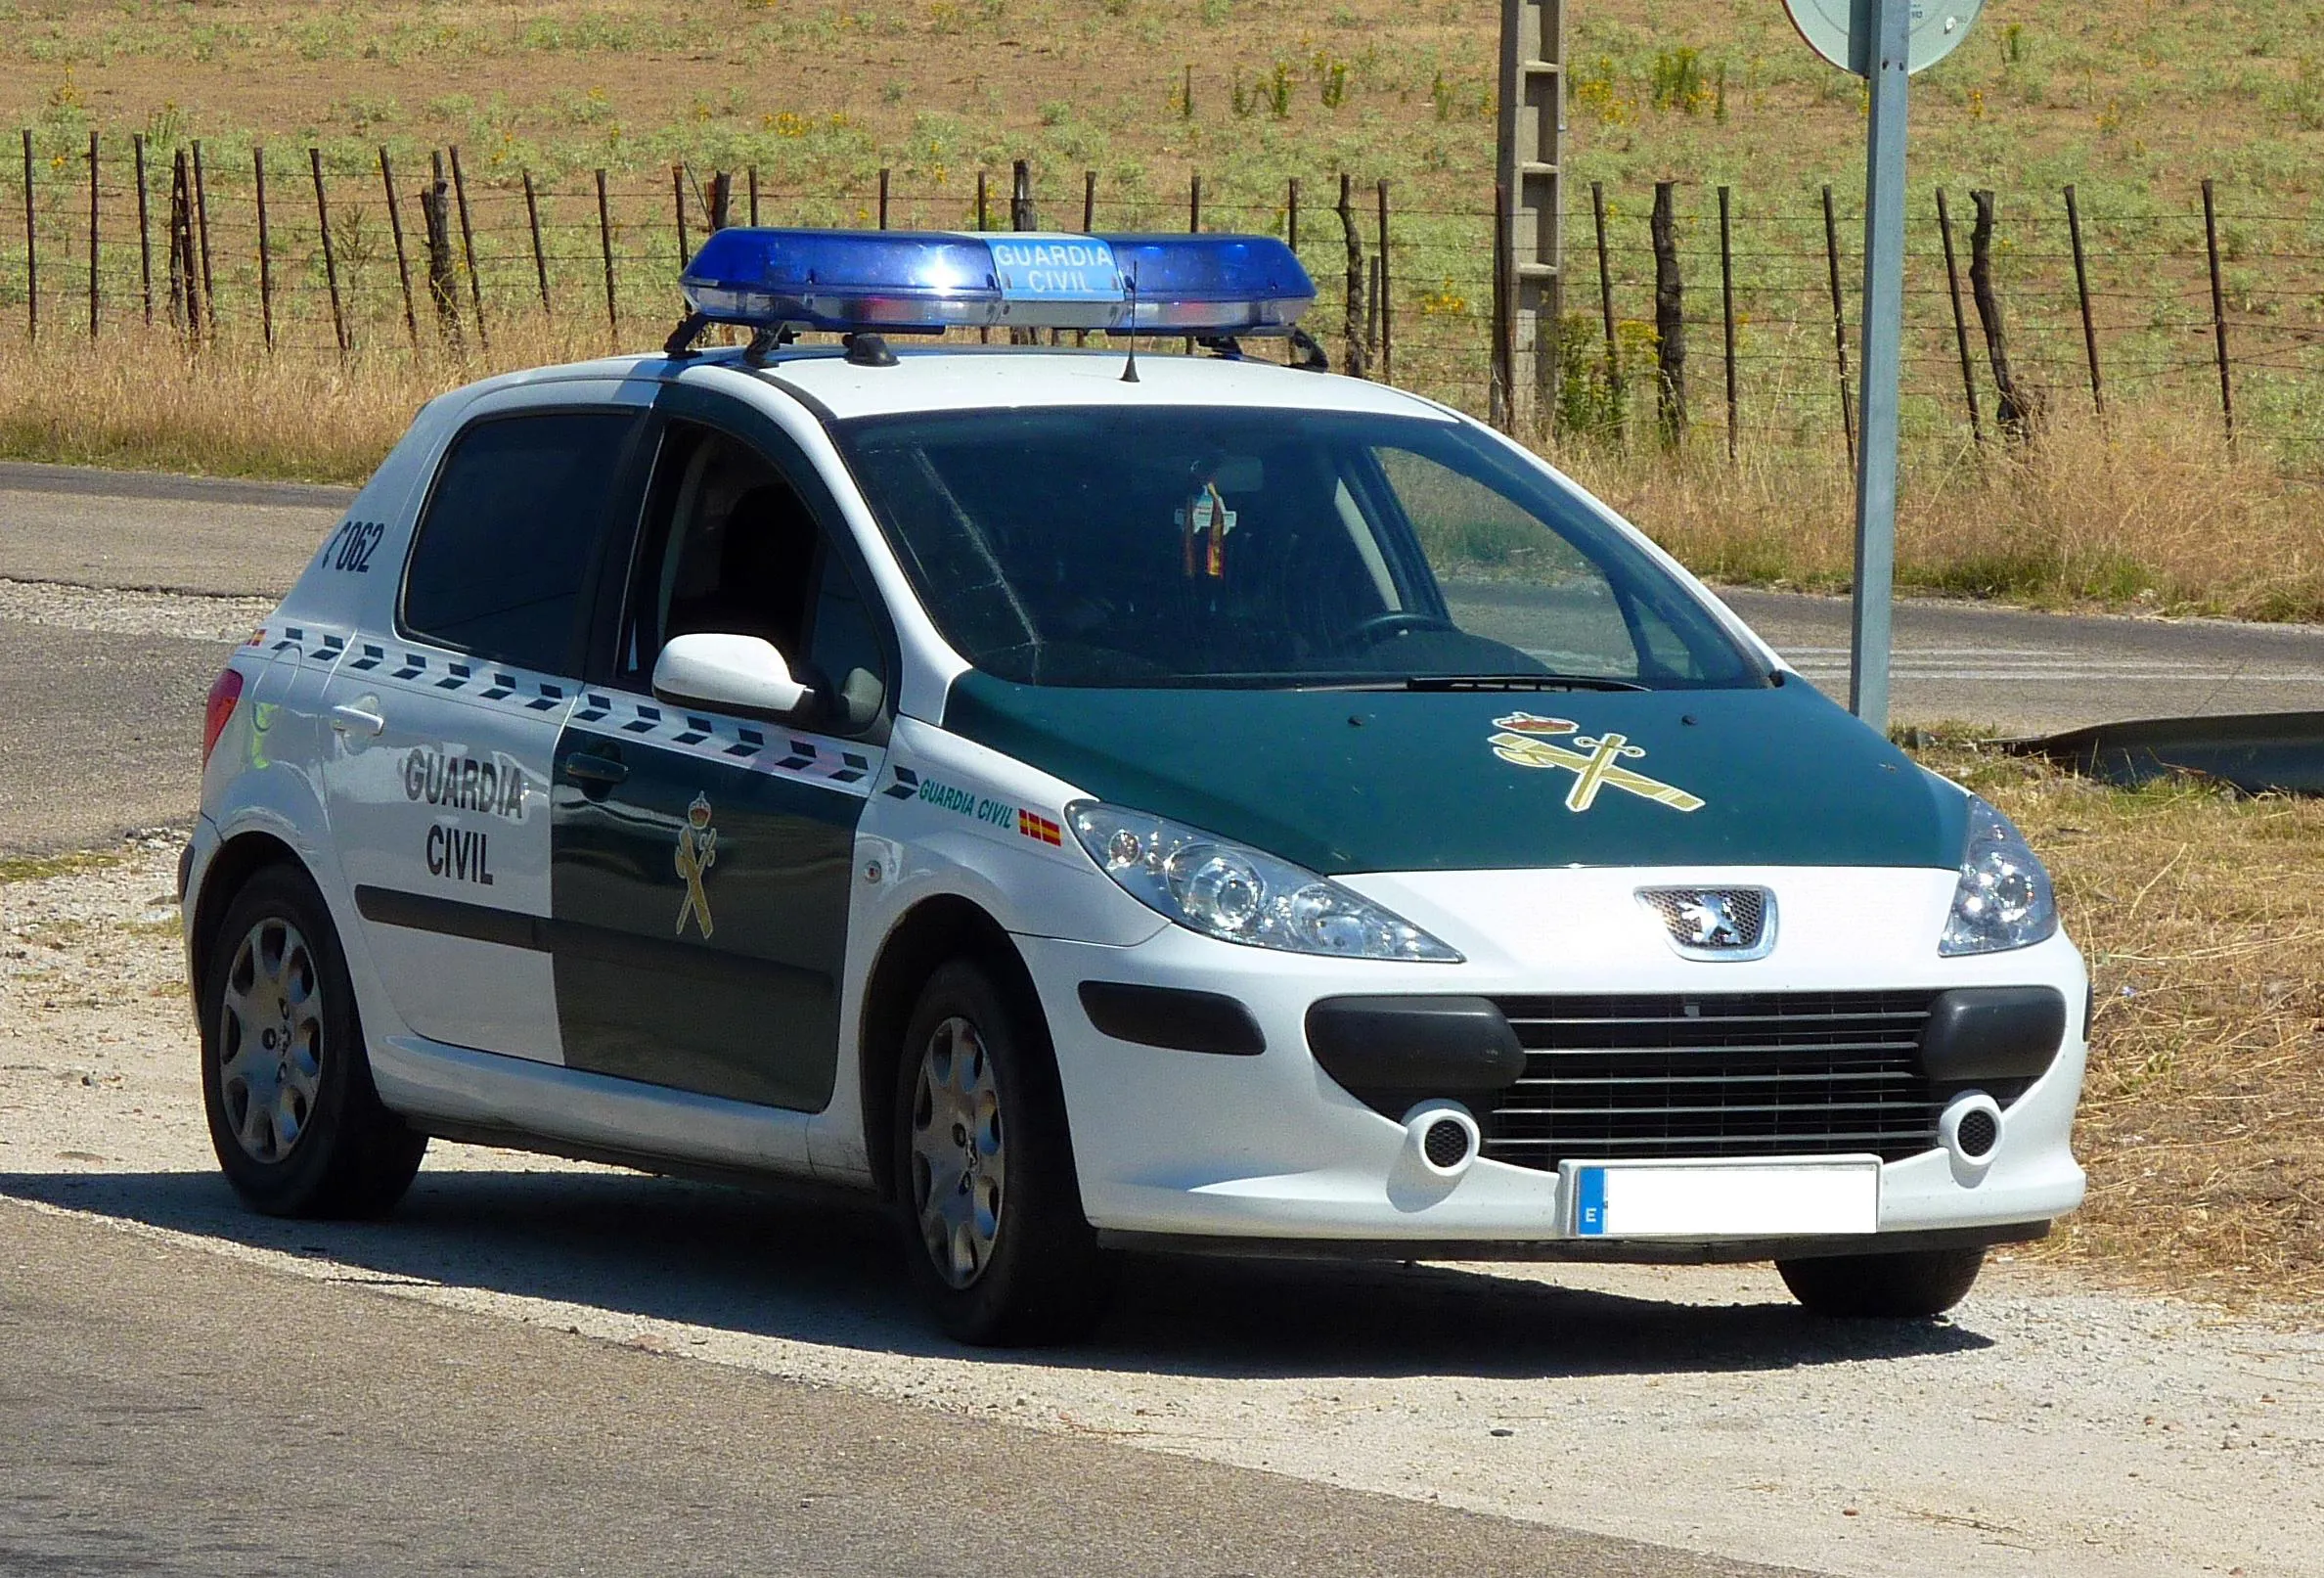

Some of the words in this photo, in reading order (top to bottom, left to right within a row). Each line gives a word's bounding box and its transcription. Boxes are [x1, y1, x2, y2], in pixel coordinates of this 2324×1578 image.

[995, 244, 1113, 267] GUARDIA
[1028, 269, 1095, 293] CIVIL
[335, 520, 385, 573] 062
[405, 747, 523, 820] GUARDIA
[918, 779, 976, 818] GUARDIA
[978, 798, 1013, 830] CIVIL
[425, 824, 494, 886] CIVIL
[1585, 1206, 1597, 1223] E
